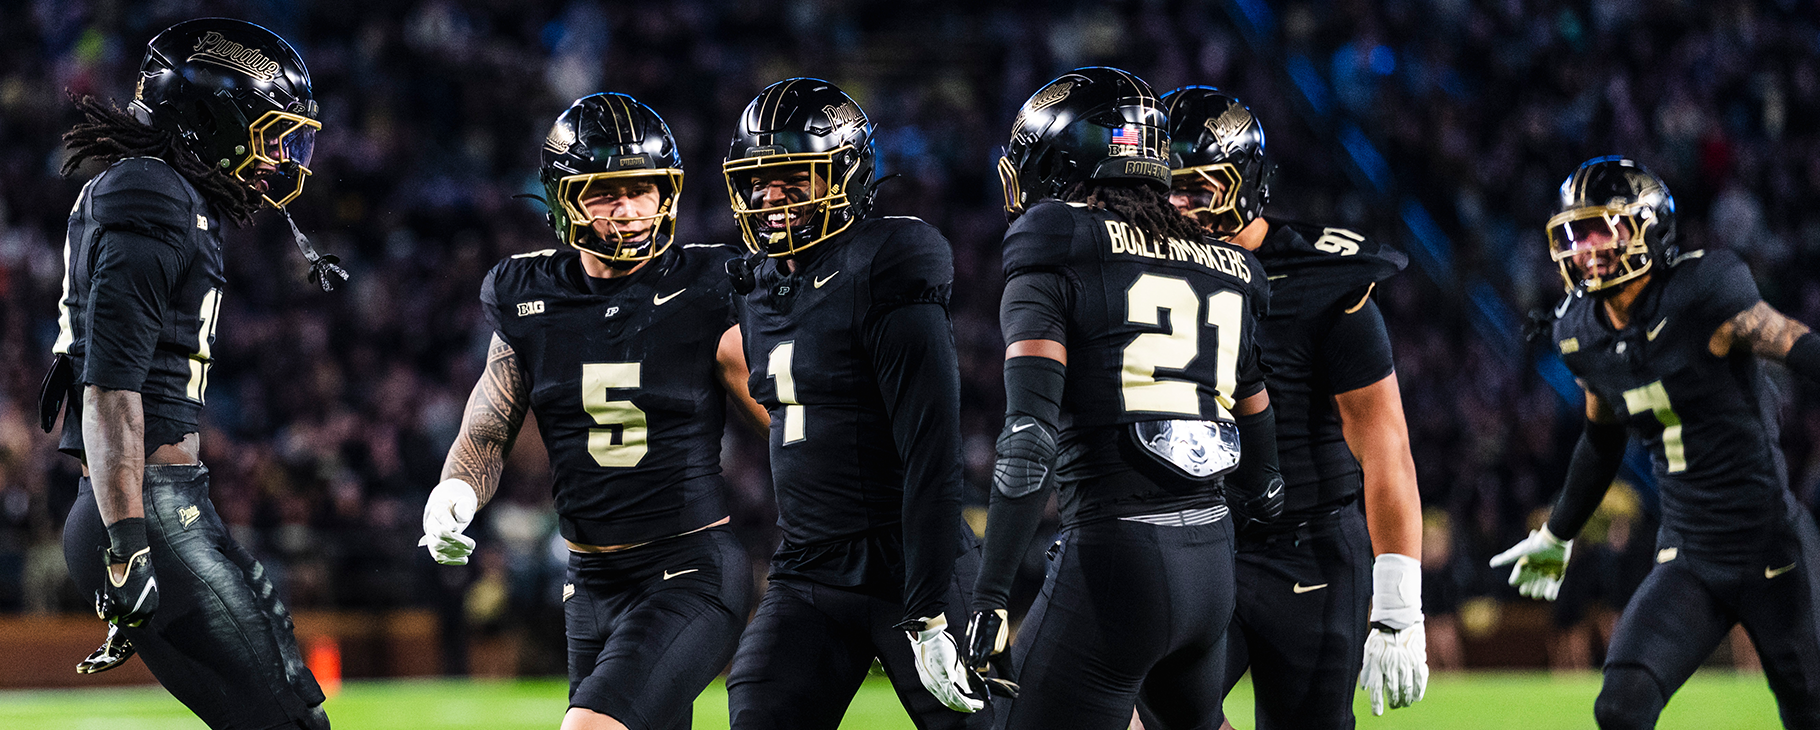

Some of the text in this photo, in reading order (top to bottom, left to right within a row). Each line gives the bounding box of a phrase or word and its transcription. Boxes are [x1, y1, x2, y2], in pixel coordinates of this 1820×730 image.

[191, 31, 280, 83] Purdue
[1314, 227, 1366, 257] 91
[605, 306, 619, 318] P
[1121, 273, 1244, 422] 21
[581, 361, 648, 468] 5
[766, 340, 807, 446] 1
[1622, 380, 1687, 474] 7
